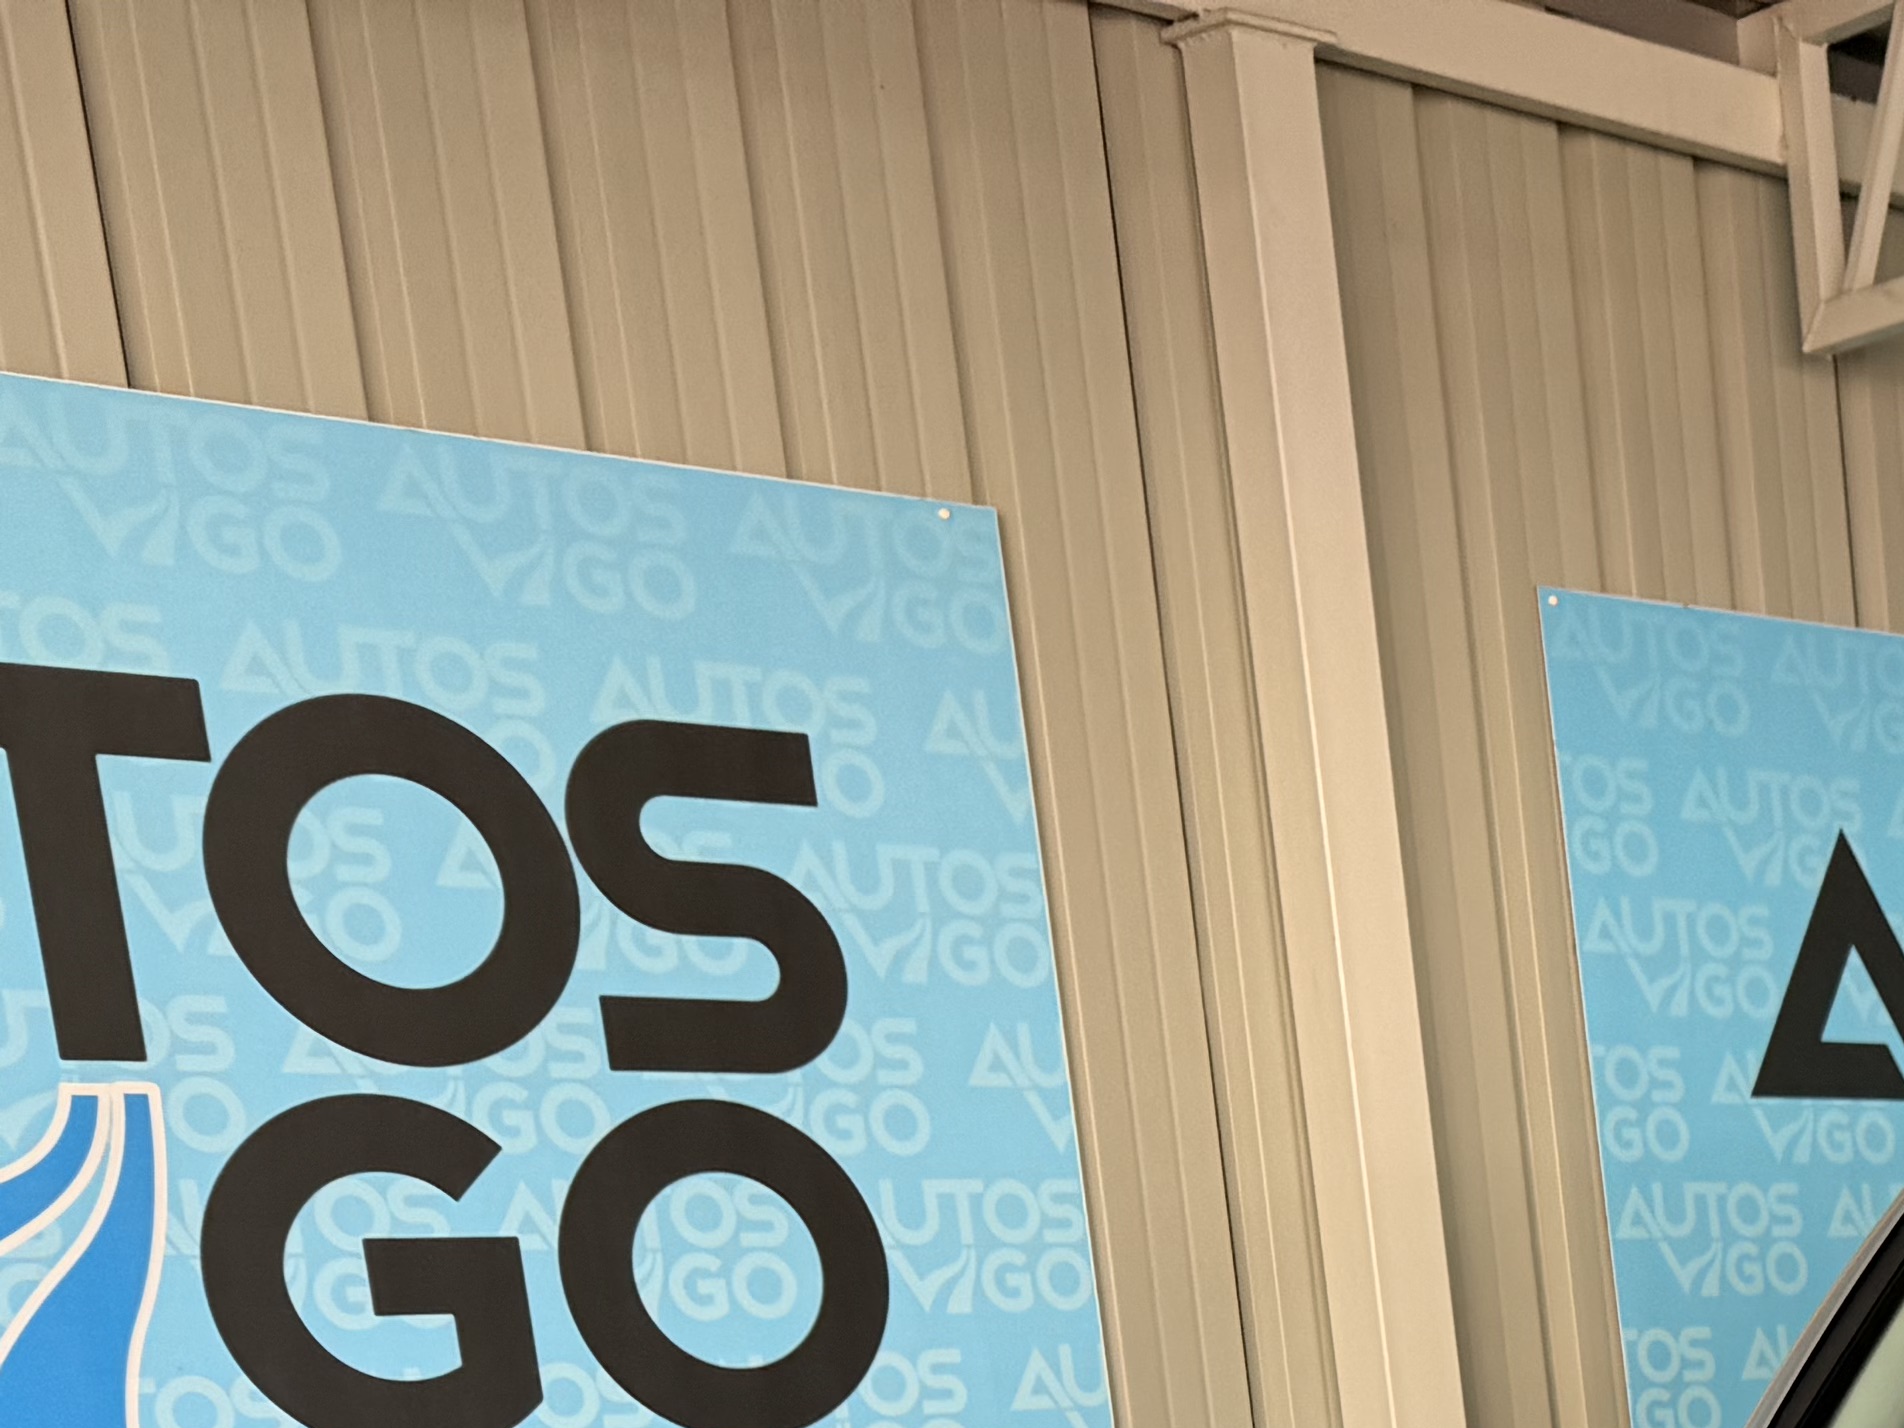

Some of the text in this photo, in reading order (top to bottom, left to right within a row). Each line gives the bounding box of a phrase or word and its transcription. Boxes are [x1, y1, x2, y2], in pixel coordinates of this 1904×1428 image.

[216, 618, 544, 715] AUTOS
[587, 655, 874, 744] AUTOS
[1678, 766, 1861, 833] AUTOS
[838, 912, 1051, 987] VIGO
[1580, 896, 1771, 960] AUTOS
[1624, 957, 1777, 1019] VIGO
[1750, 1107, 1893, 1163] VIGO
[1612, 1182, 1799, 1239] AUTOS
[885, 1247, 1092, 1312] VIGO
[1656, 1241, 1805, 1297] VIGO
